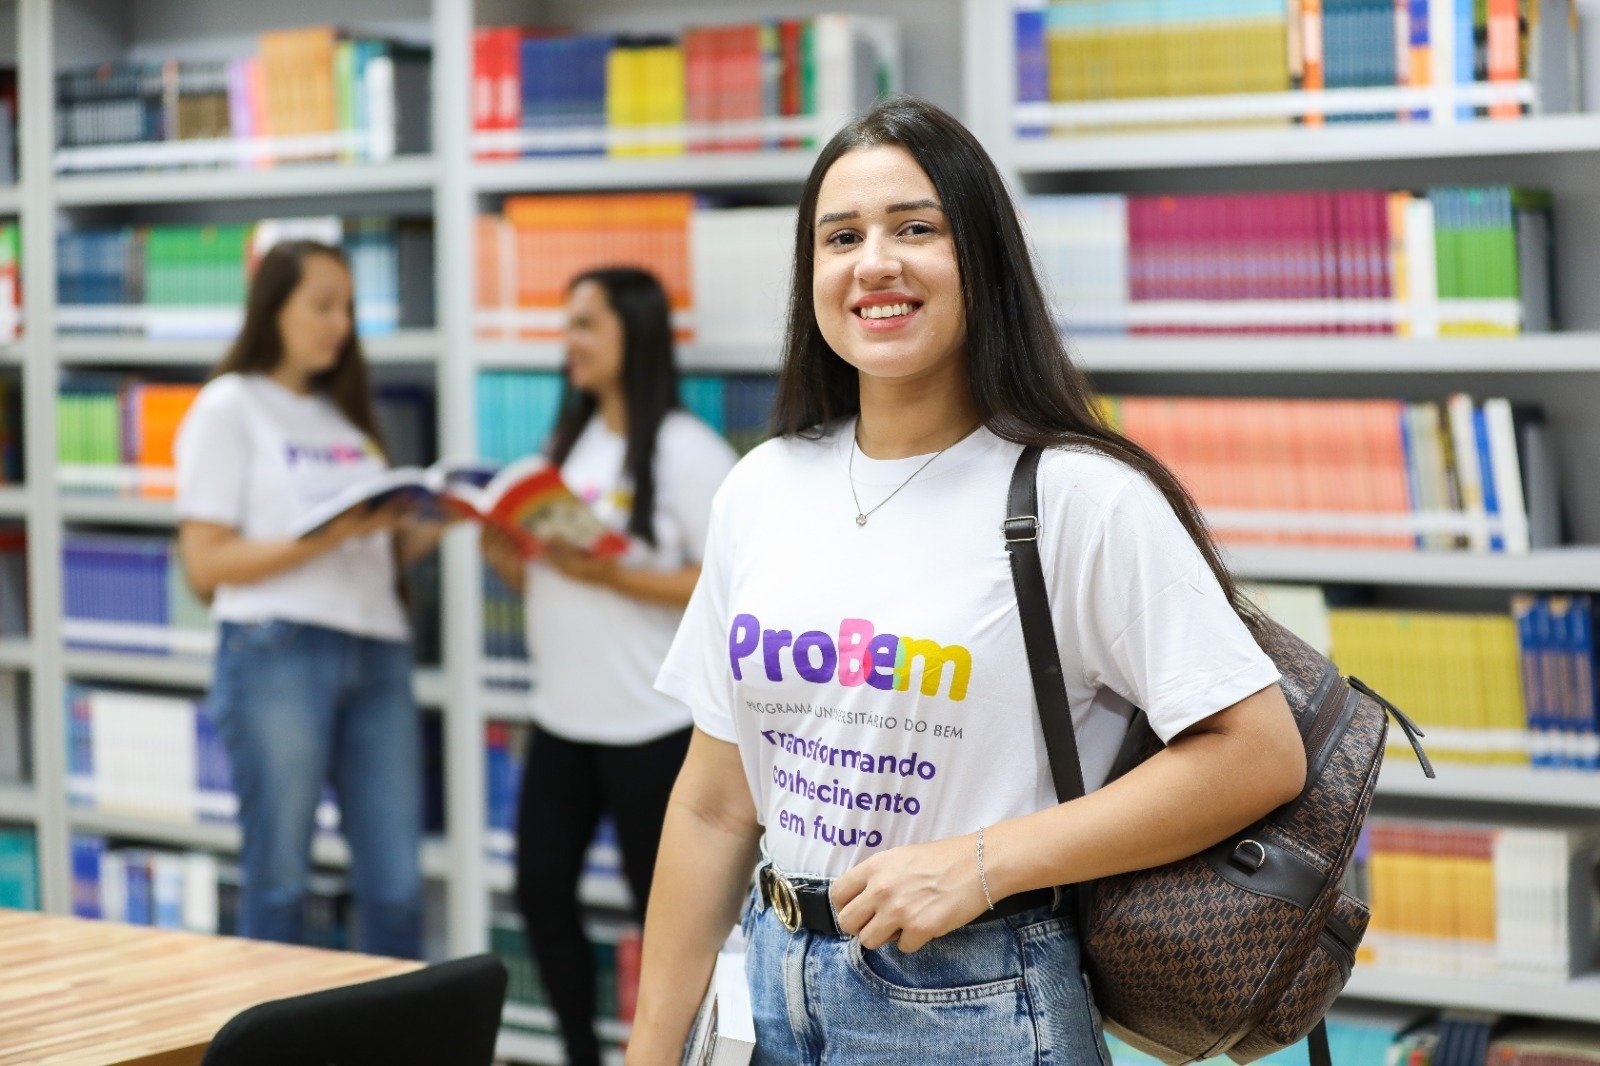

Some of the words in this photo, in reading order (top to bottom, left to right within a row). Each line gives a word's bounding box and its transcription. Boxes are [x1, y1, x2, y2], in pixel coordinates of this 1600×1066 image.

[729, 614, 972, 702] ProBem
[746, 701, 813, 715] PROGRAMA
[904, 718, 927, 733] DO
[933, 724, 963, 739] BEM
[779, 809, 806, 837] em
[813, 815, 883, 848] fuuro
